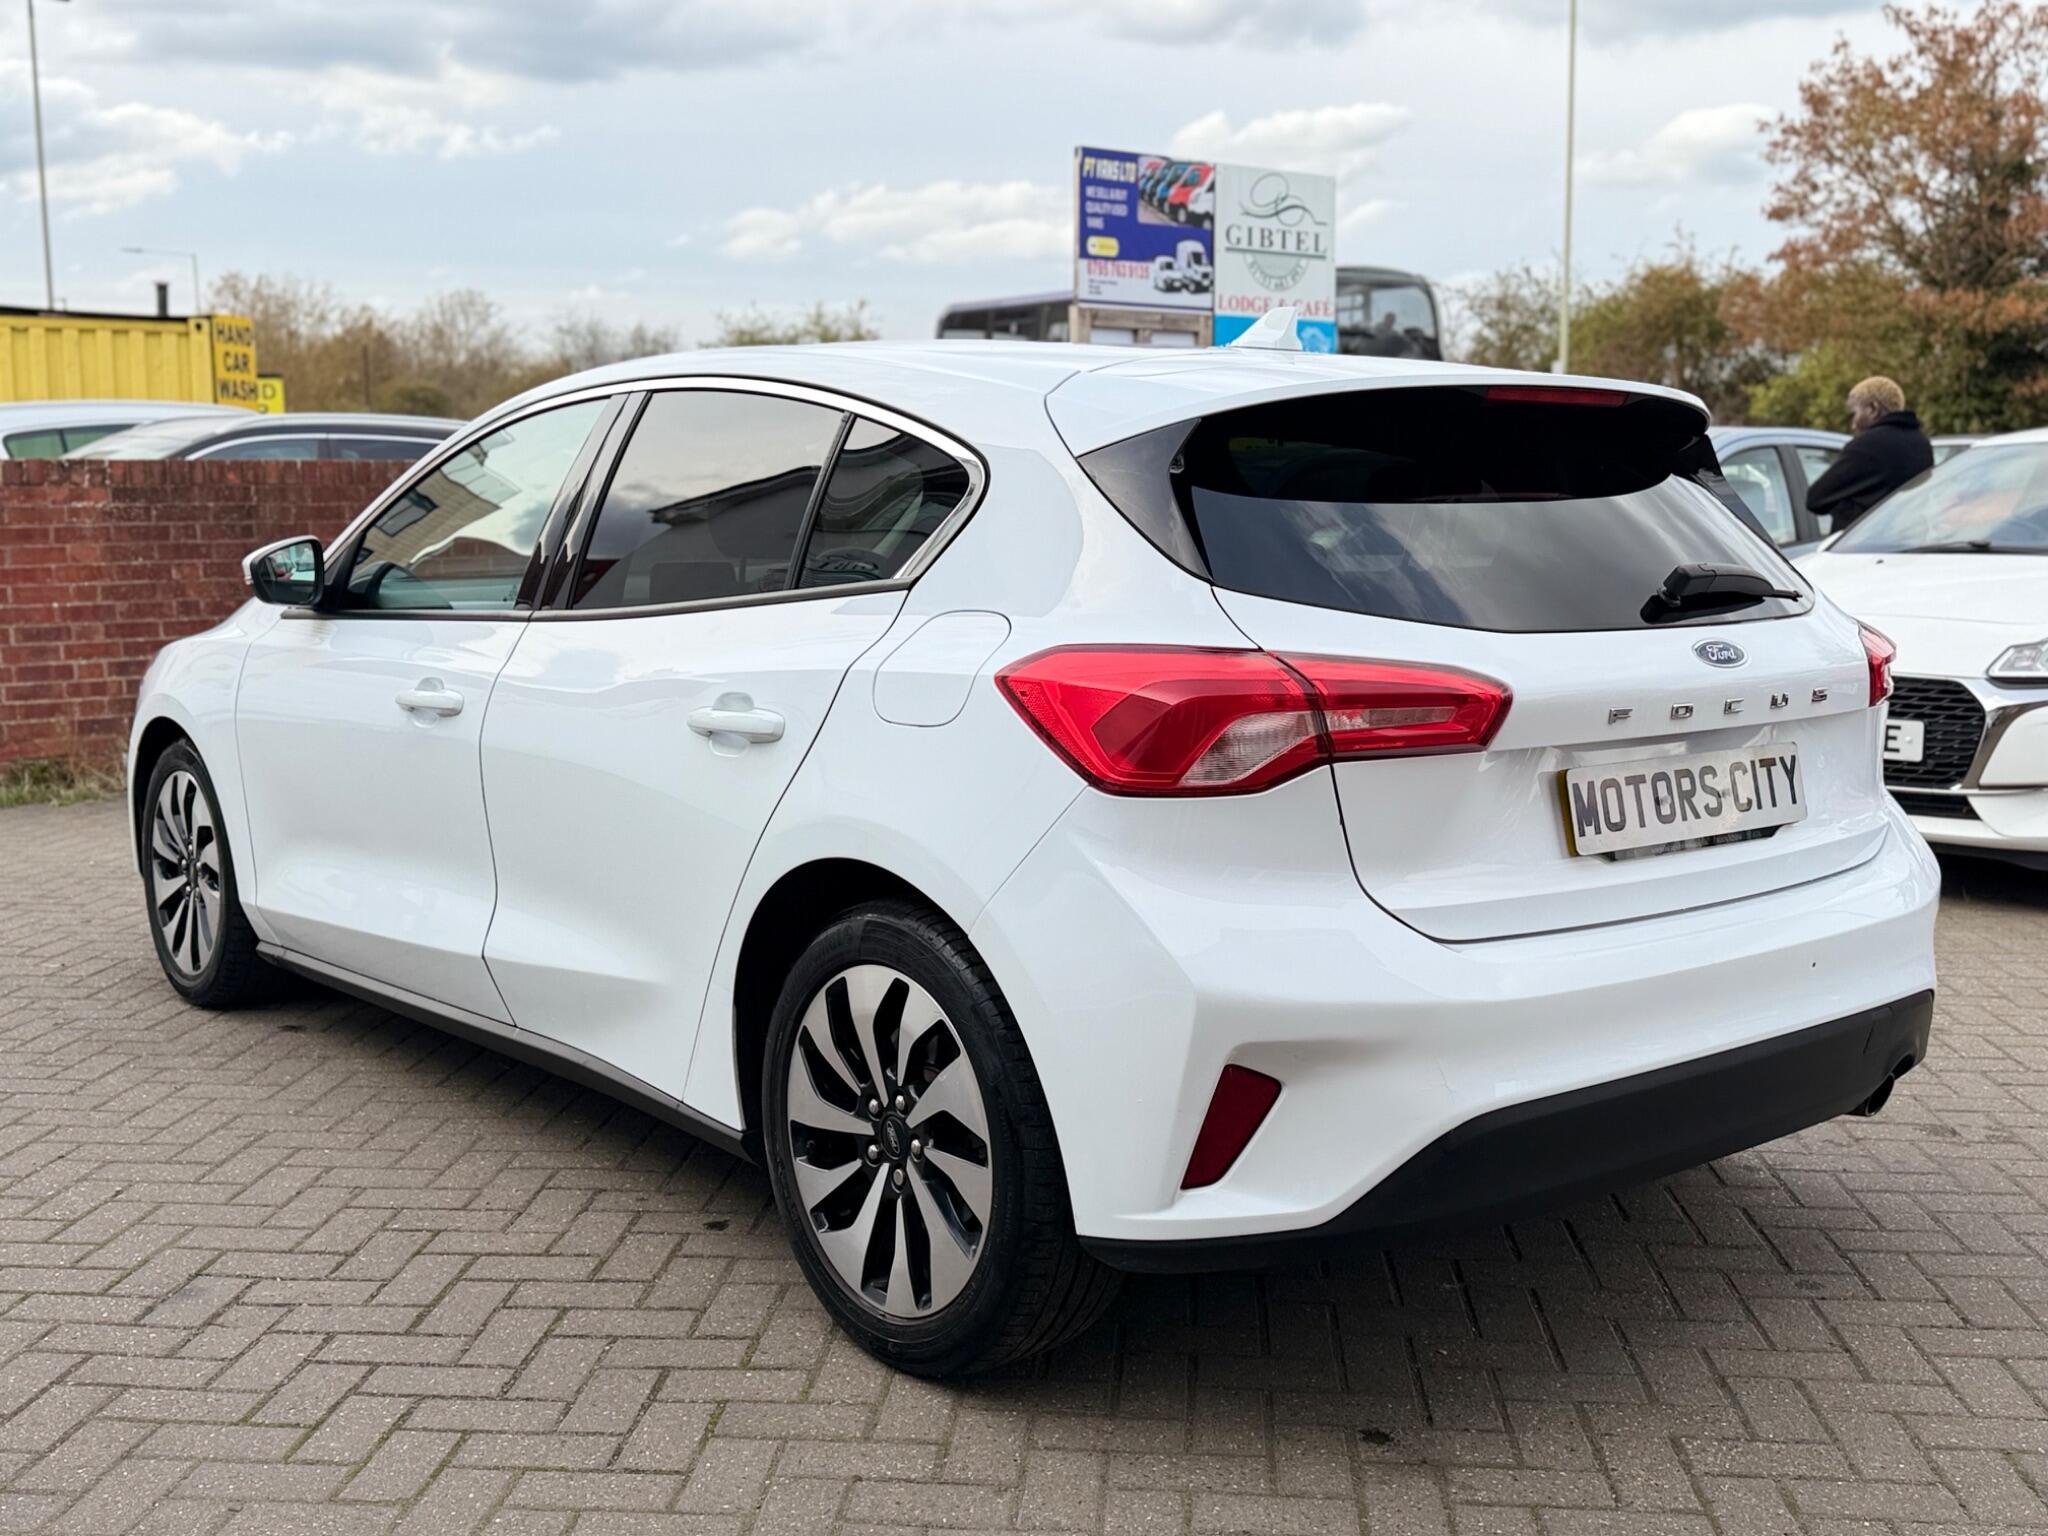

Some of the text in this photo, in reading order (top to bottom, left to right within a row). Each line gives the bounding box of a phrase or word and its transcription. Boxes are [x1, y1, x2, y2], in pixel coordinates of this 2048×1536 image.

[1225, 224, 1328, 254] GIBTEL
[1218, 294, 1272, 314] LODGE
[216, 324, 252, 347] HAND
[224, 351, 250, 373] CAR
[218, 379, 259, 402] WASH
[1706, 644, 1737, 660] Ford
[1608, 686, 1828, 725] FOCUS
[1571, 754, 1798, 838] MOTORS CITY
